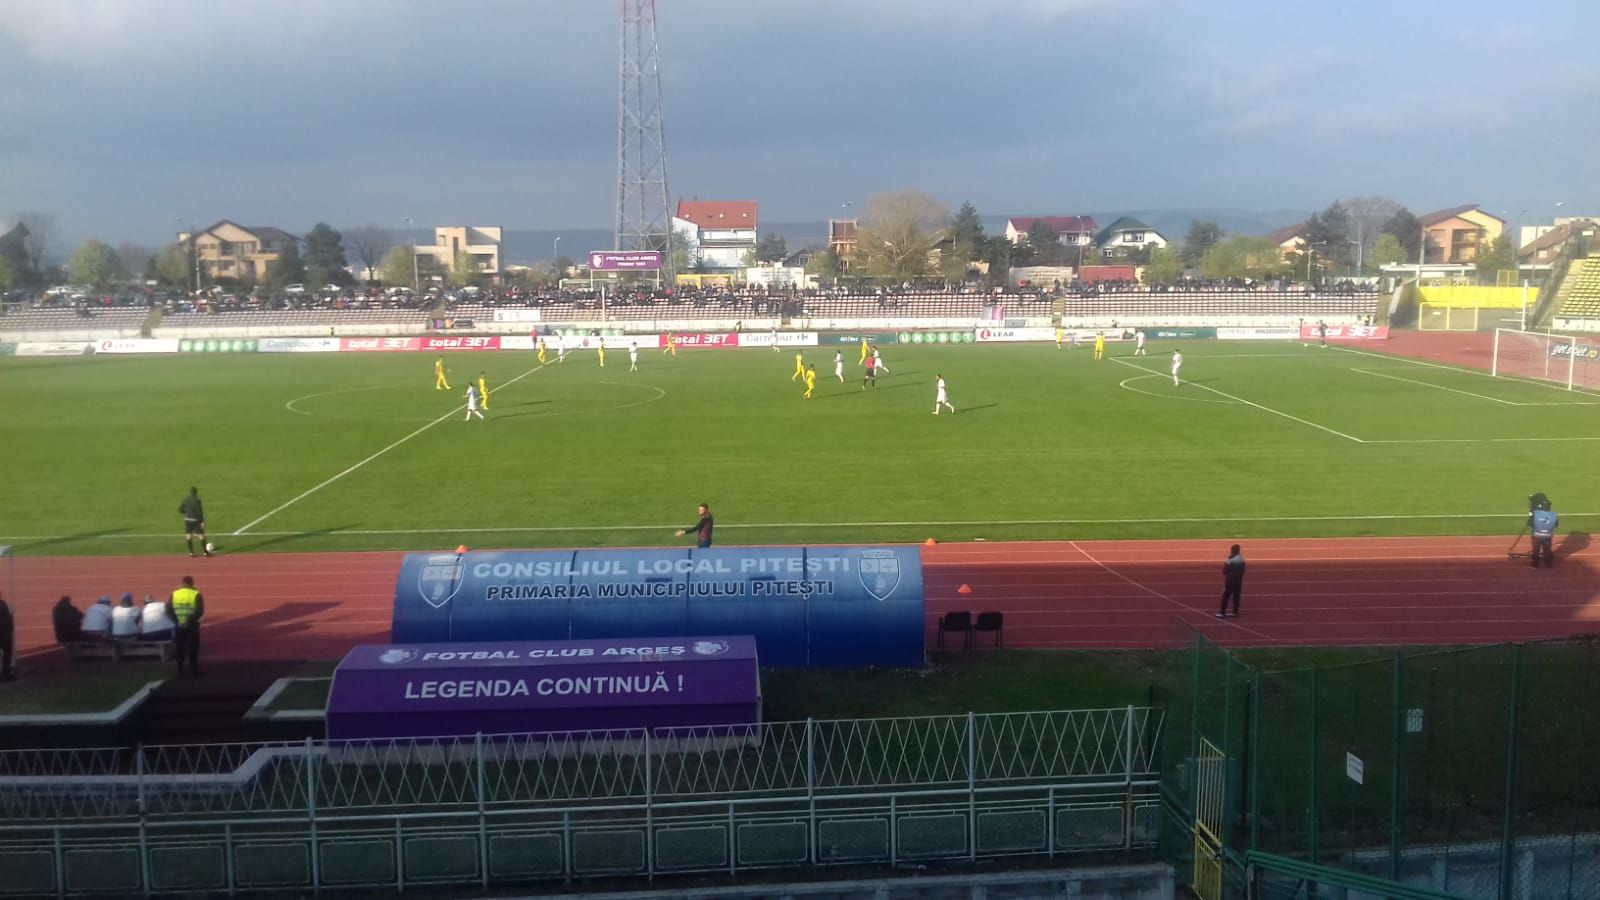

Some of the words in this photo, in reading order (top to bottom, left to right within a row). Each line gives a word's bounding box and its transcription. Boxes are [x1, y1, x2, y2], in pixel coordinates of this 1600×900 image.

[348, 340, 378, 348] total
[429, 337, 462, 347] total
[473, 559, 627, 578] CONSILIUL
[637, 558, 731, 575] LOCAL
[598, 580, 745, 599] MUNICIPIULUI
[422, 651, 521, 661] FOTBAL
[528, 648, 595, 658] CLUB
[405, 679, 530, 699] LEGENDA
[536, 671, 670, 695] CONTINUĂ
